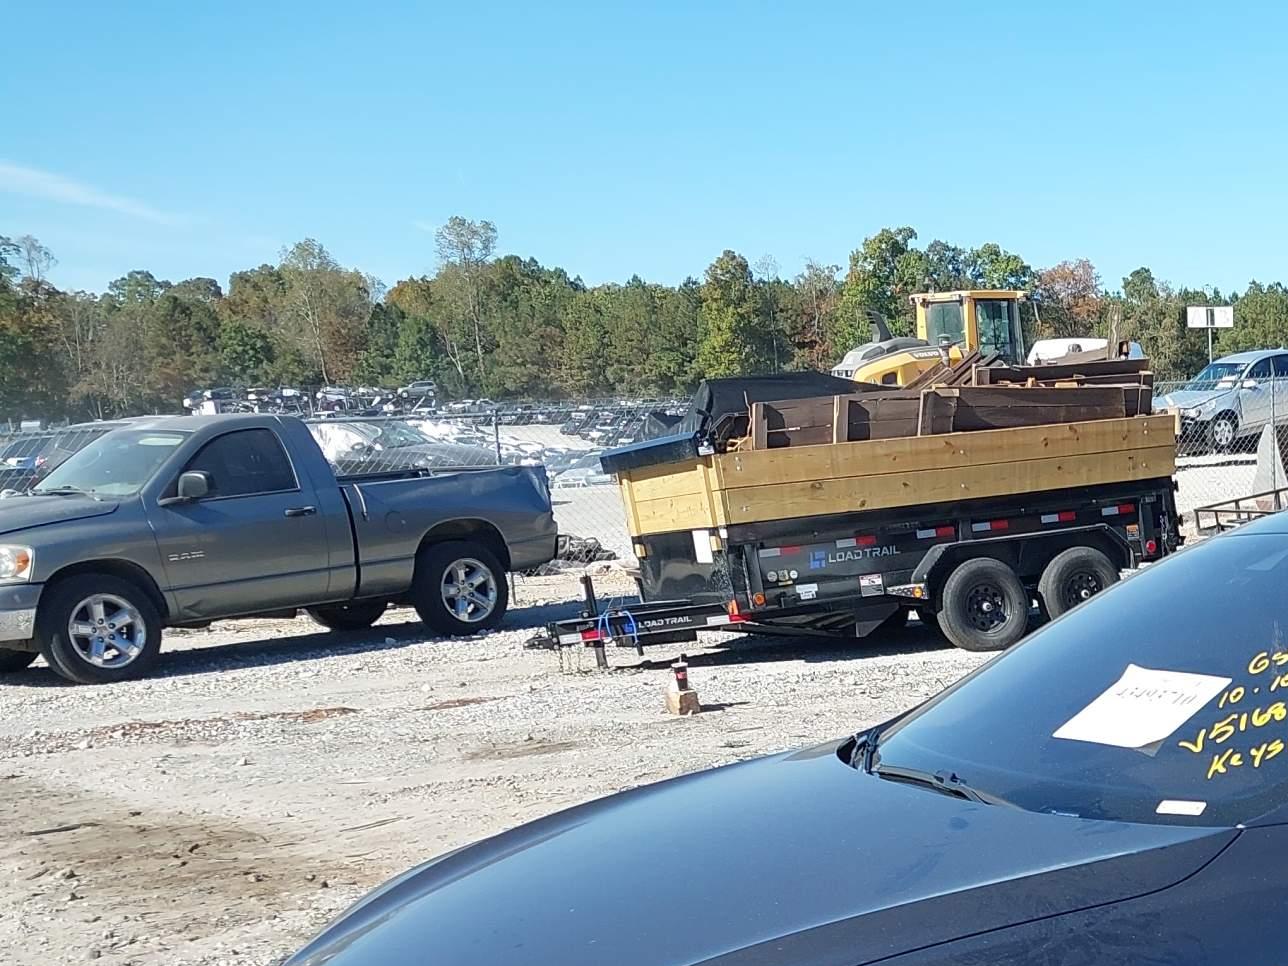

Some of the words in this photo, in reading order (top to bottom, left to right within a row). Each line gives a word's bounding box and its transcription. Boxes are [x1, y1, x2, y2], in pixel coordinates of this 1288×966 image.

[913, 350, 939, 358] VOLVO
[828, 549, 863, 563] LOAD
[864, 544, 901, 558] TRAIL
